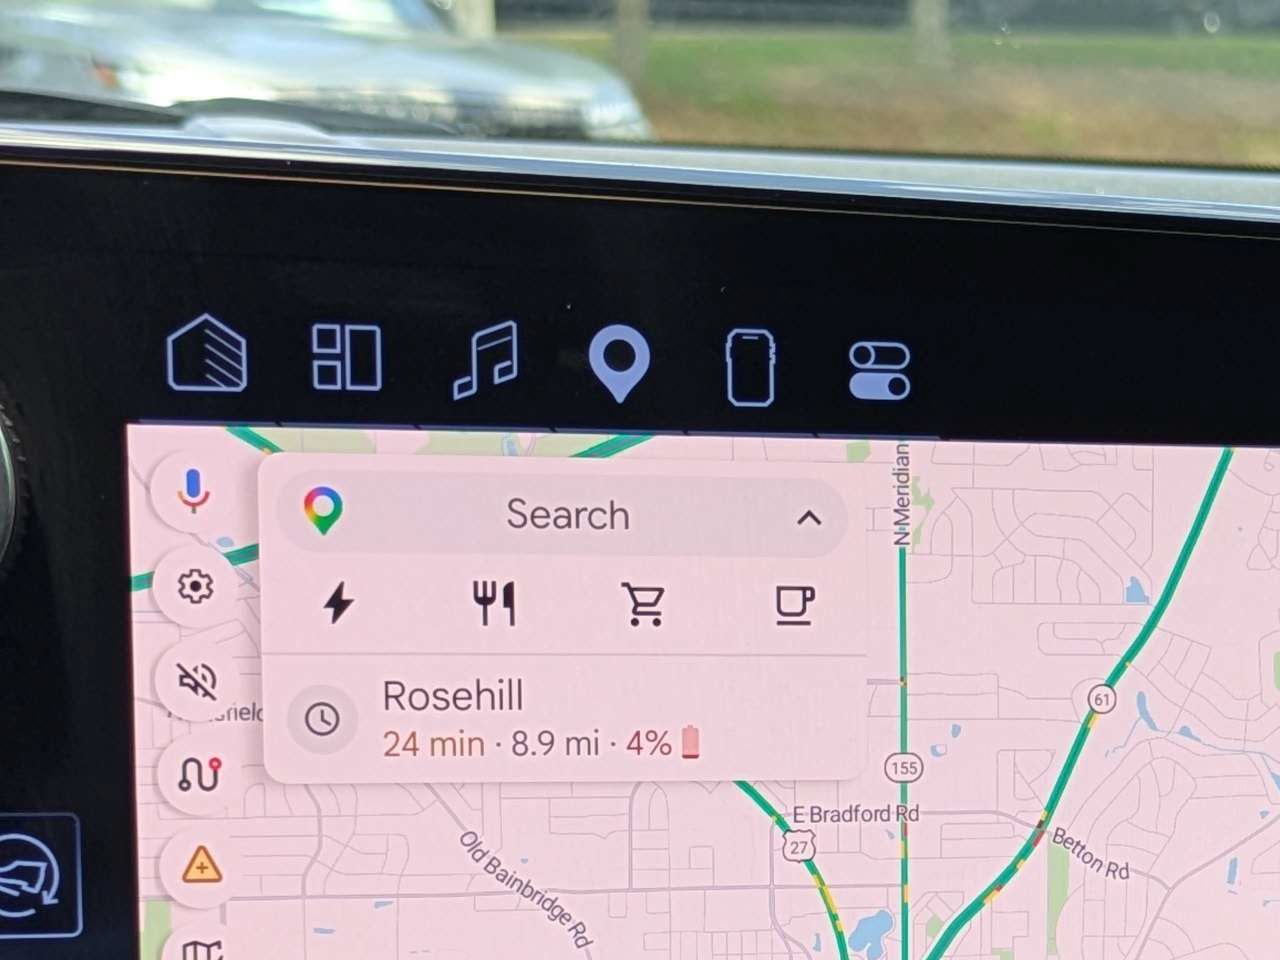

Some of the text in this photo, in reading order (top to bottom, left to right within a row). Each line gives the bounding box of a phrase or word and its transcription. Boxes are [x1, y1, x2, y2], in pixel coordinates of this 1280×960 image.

[892, 443, 911, 545] N Meridian
[507, 498, 630, 532] Search
[383, 678, 524, 713] Rosehill
[1094, 693, 1110, 707] 61
[383, 729, 673, 758] 24 min 8.9 mi 4%
[892, 761, 917, 775] 155
[793, 805, 920, 823] E Bradford Rd
[790, 841, 807, 855] 27
[1053, 827, 1131, 880] Betton Rd
[460, 830, 594, 949] Old Bainbridge Rd
